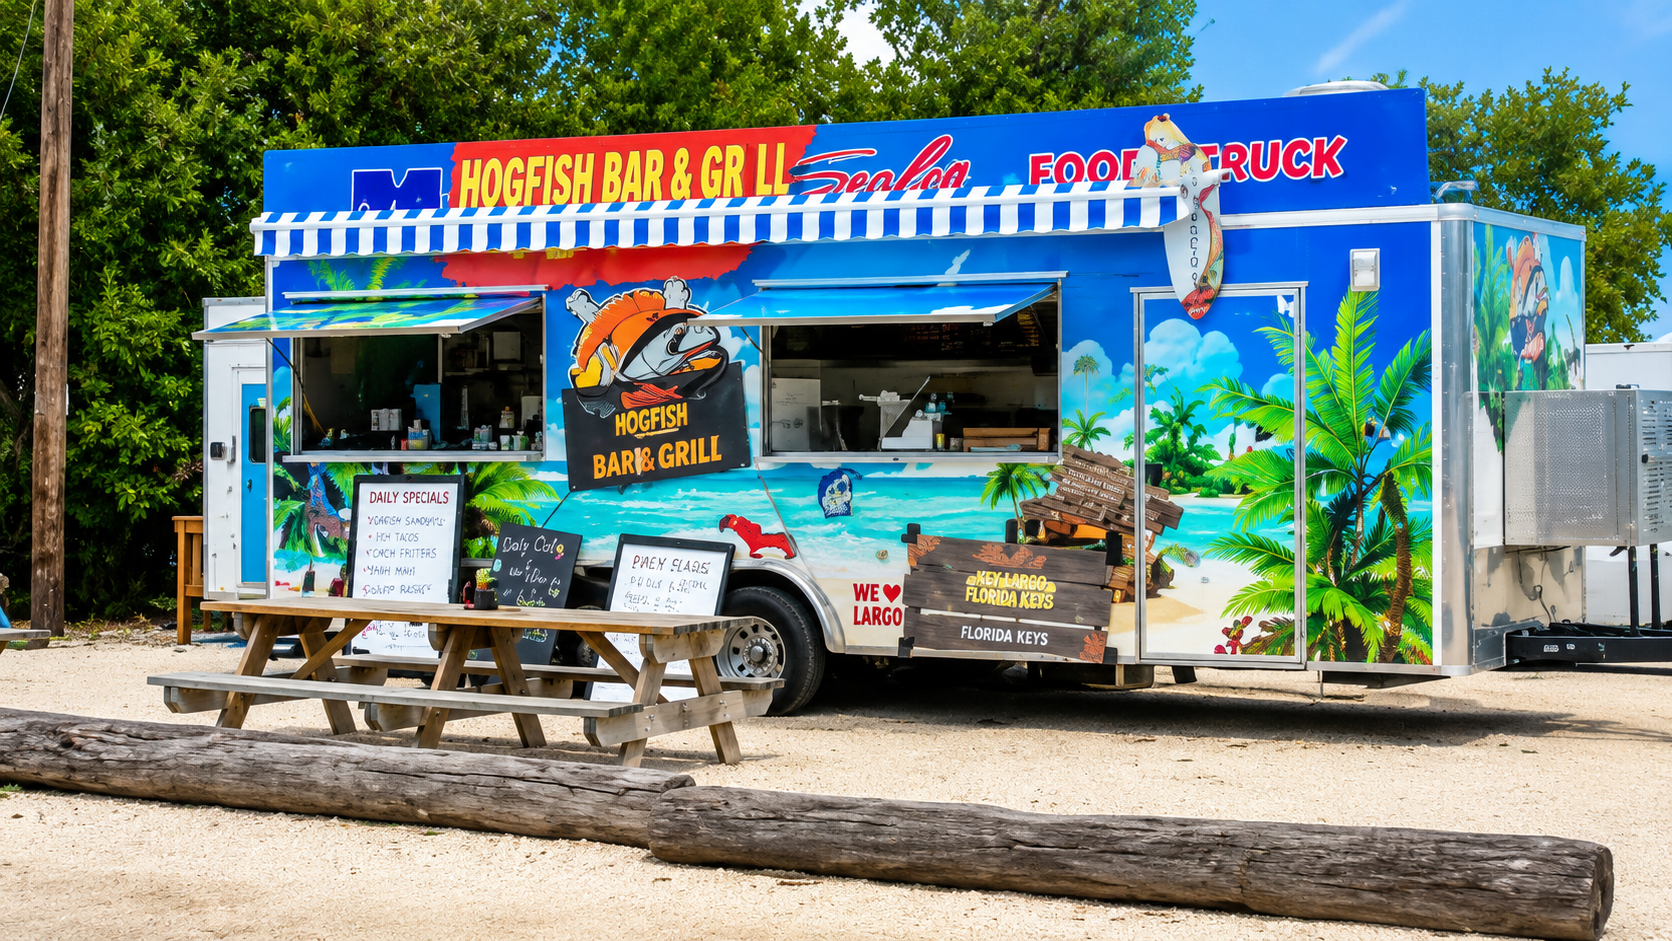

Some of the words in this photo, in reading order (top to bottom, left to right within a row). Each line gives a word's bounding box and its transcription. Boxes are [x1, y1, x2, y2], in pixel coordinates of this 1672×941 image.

[459, 152, 595, 208] HOGFISH
[602, 148, 663, 203] BAR
[670, 147, 693, 200] &
[615, 402, 688, 436] HOGFISH
[593, 449, 635, 479] BAR
[640, 446, 655, 473] &
[658, 435, 722, 470] GRILL
[369, 491, 399, 504] DAILY
[402, 491, 449, 505] SPECIALS
[976, 570, 1003, 588] KEY
[1004, 572, 1047, 591] LARGO
[853, 583, 880, 602] WE
[965, 586, 1018, 608] FLORIDA
[1018, 590, 1054, 610] KEYS
[853, 606, 902, 626] LARGO
[960, 625, 1013, 643] FLORIDA
[1017, 629, 1049, 646] KEYS
